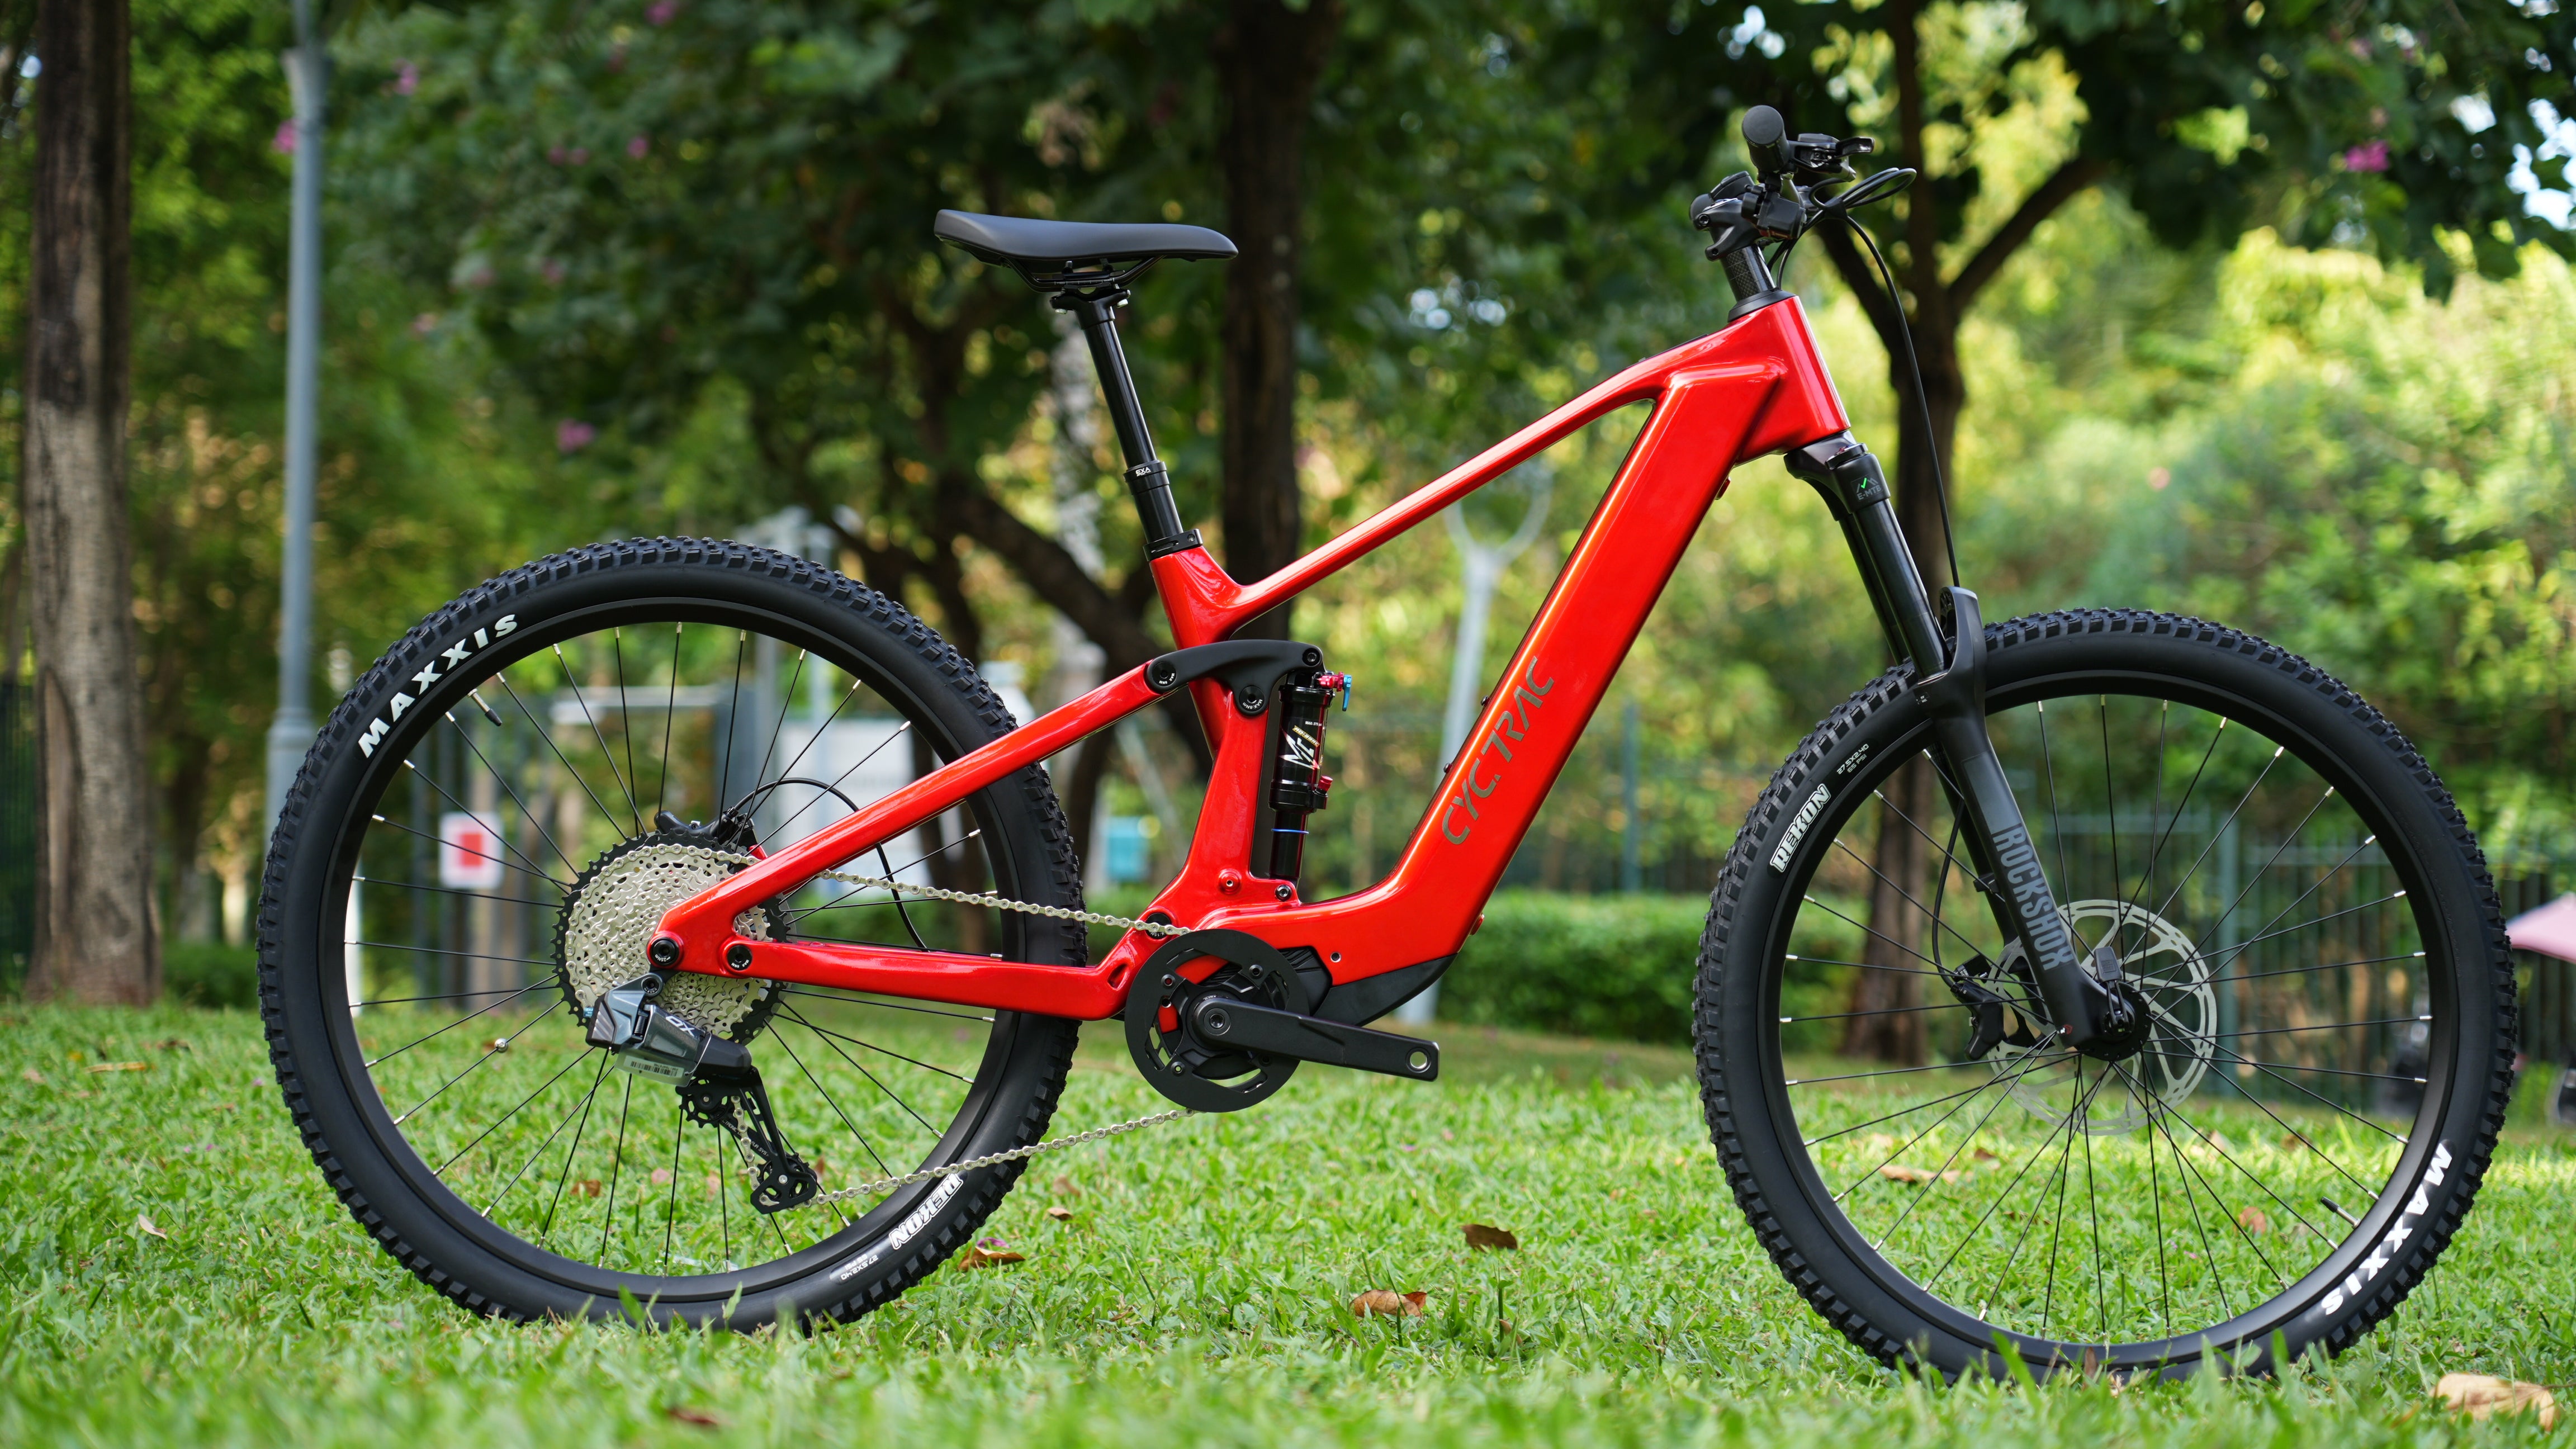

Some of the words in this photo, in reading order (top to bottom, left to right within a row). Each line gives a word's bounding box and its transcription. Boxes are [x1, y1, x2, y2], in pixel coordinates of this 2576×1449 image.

[1135, 467, 1152, 475] EXA
[1857, 485, 1882, 500] E-MTB
[358, 614, 518, 758] MAXXIS
[1770, 783, 1831, 873] REKON
[1992, 825, 2074, 971] ROCKSHOX
[889, 1173, 964, 1250] REKON
[2321, 1143, 2452, 1315] MAXXIS
